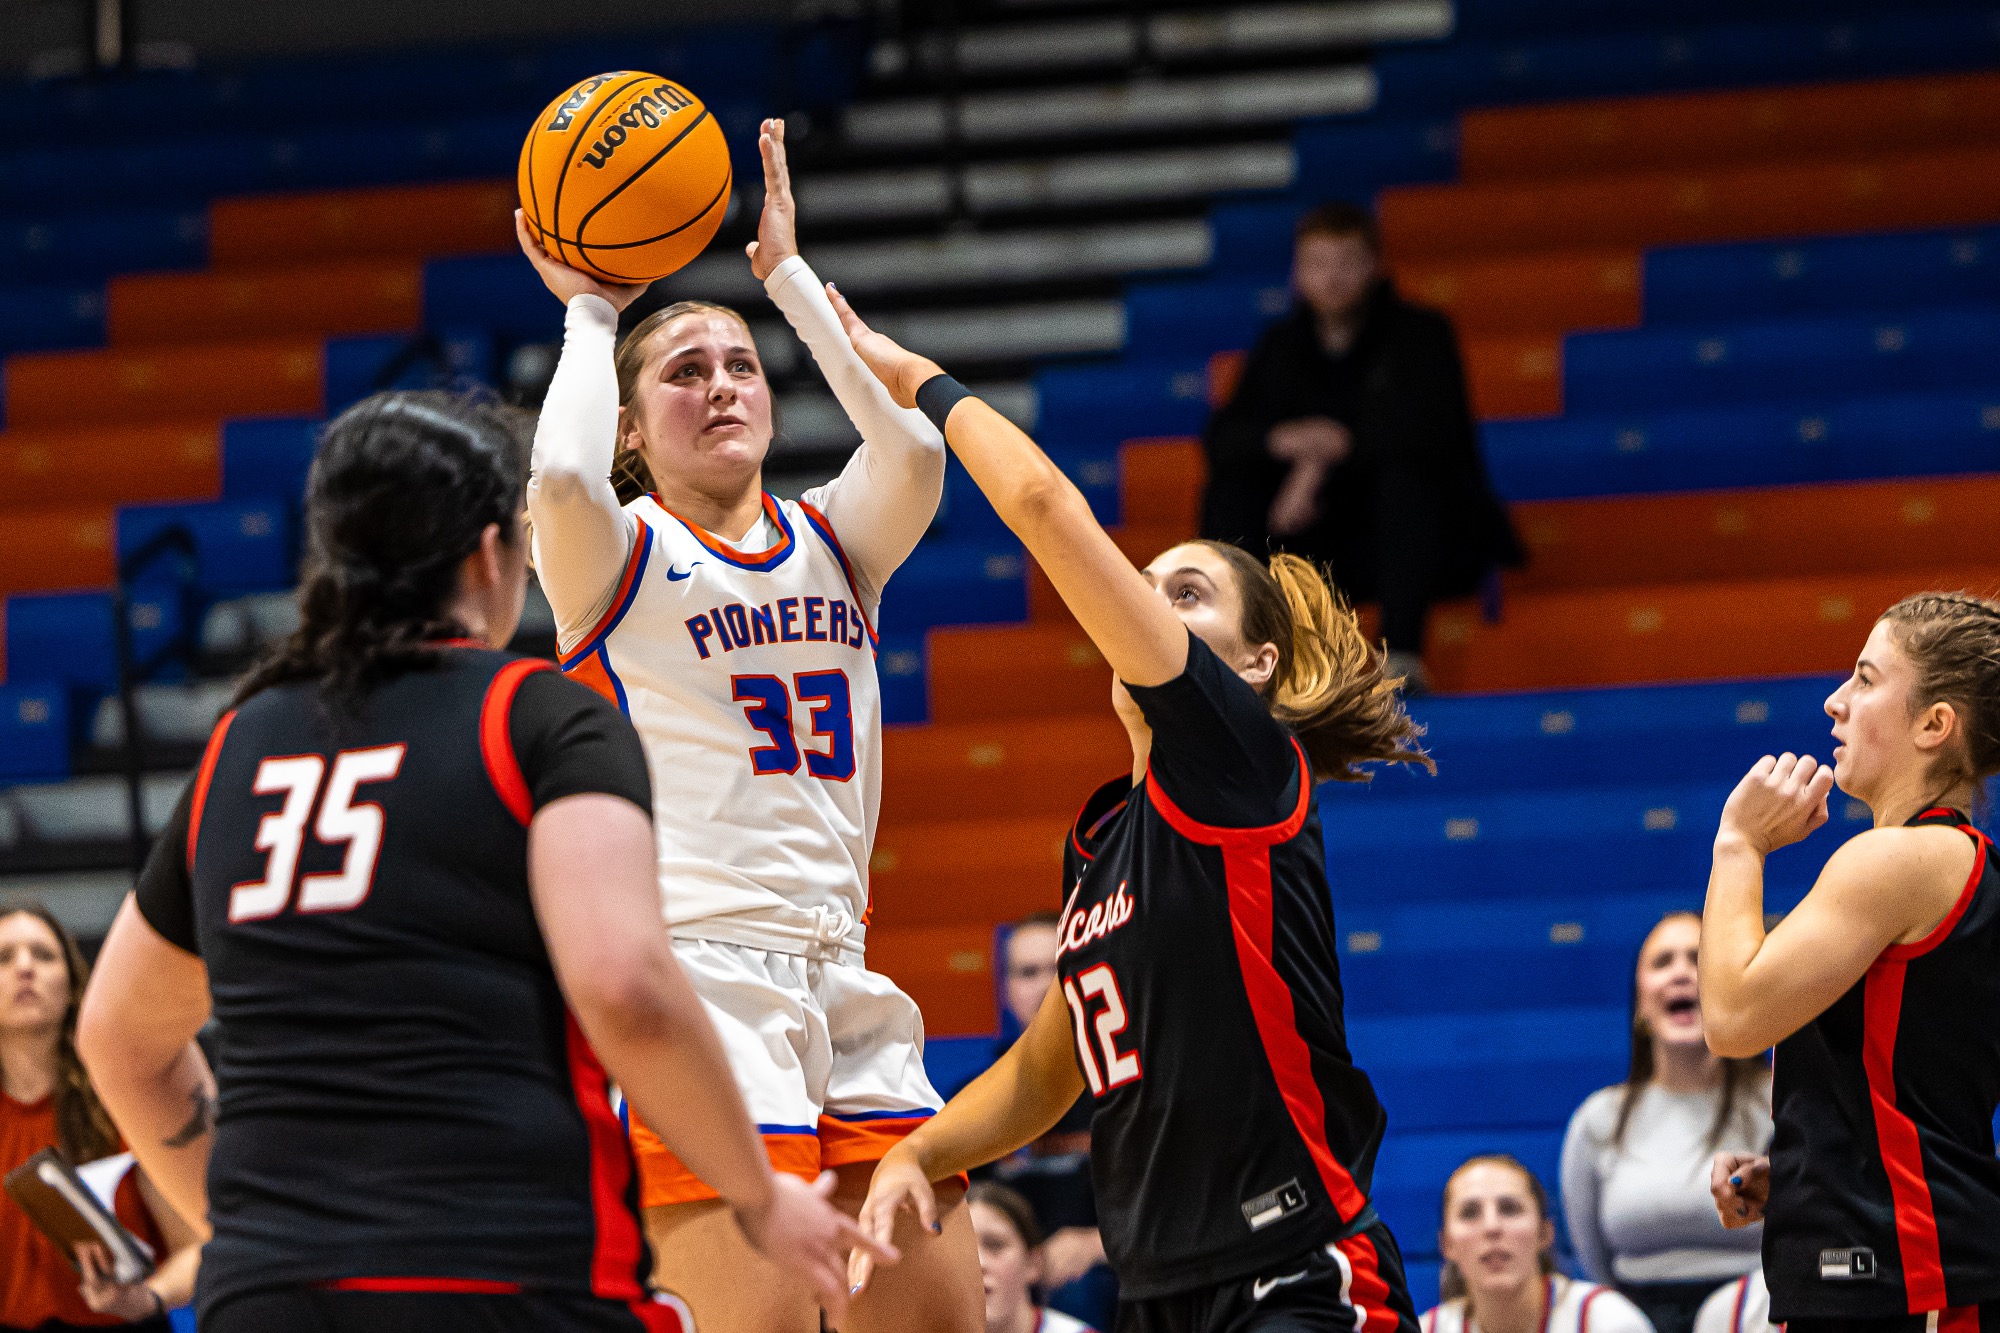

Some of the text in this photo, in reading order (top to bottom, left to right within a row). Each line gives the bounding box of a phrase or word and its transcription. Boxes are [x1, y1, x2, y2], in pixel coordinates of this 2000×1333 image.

[582, 84, 694, 170] Wilson
[684, 597, 864, 660] PIONEERS
[731, 668, 856, 783] 33
[228, 742, 407, 925] 35
[1063, 961, 1142, 1098] 12
[1284, 1192, 1297, 1207] L
